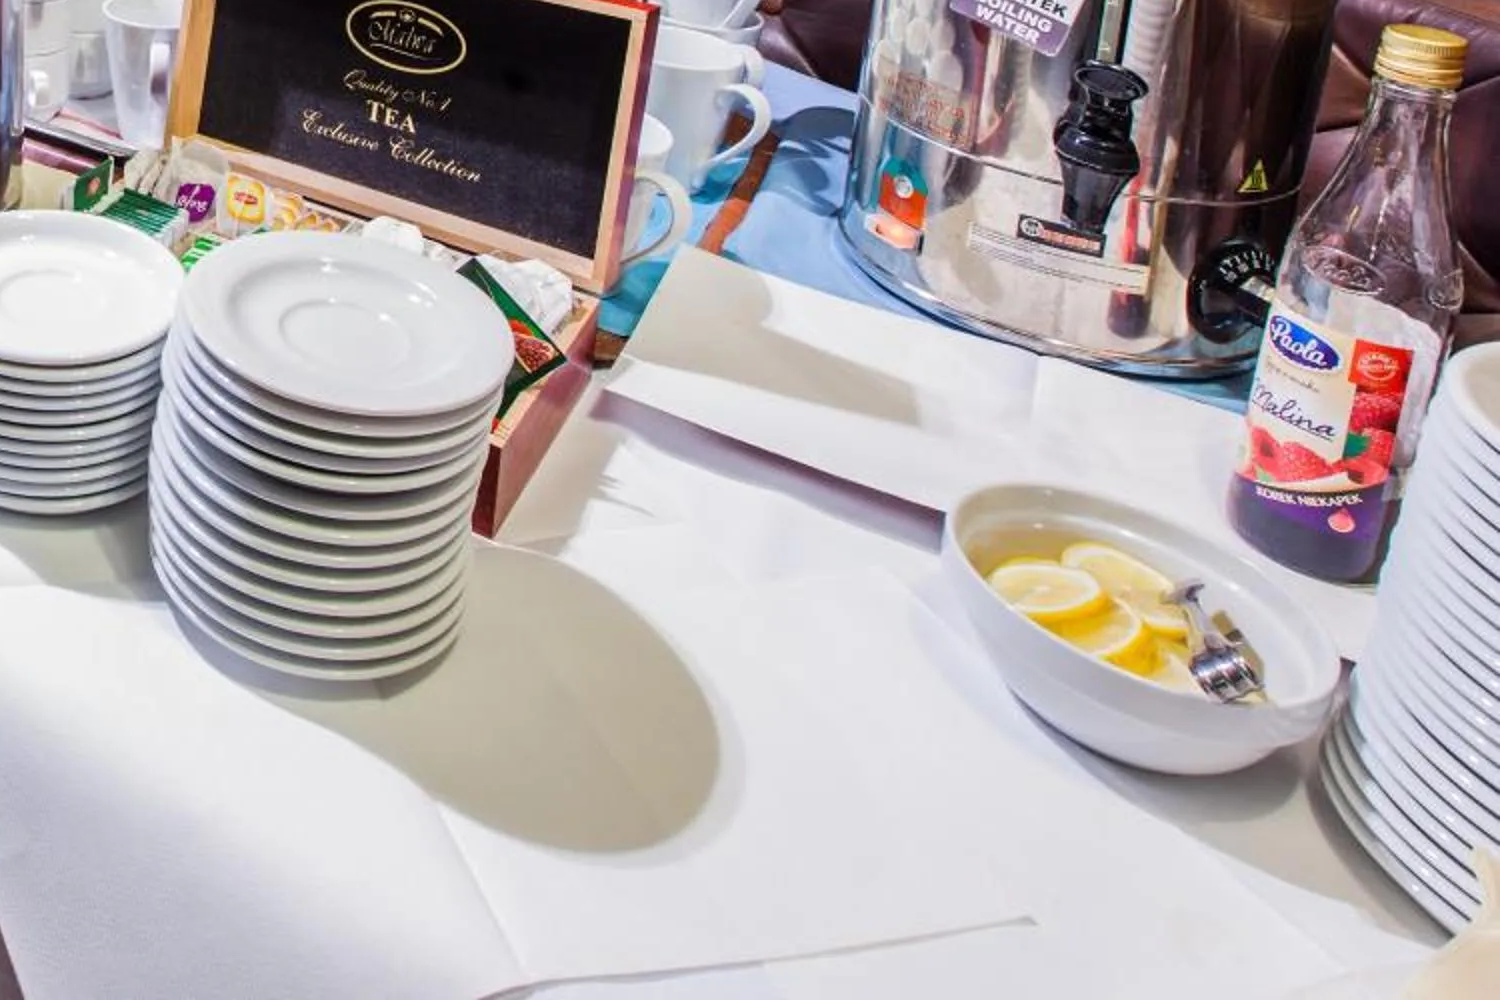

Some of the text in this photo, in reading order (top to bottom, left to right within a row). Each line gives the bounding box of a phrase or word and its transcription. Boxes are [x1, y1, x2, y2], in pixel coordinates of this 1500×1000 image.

[975, 4, 1041, 45] WATER
[343, 69, 400, 103] Quality
[365, 99, 416, 134] TEA
[302, 107, 482, 183] Exclusive Collection
[1270, 317, 1328, 367] Paola
[1251, 384, 1337, 438] Malina
